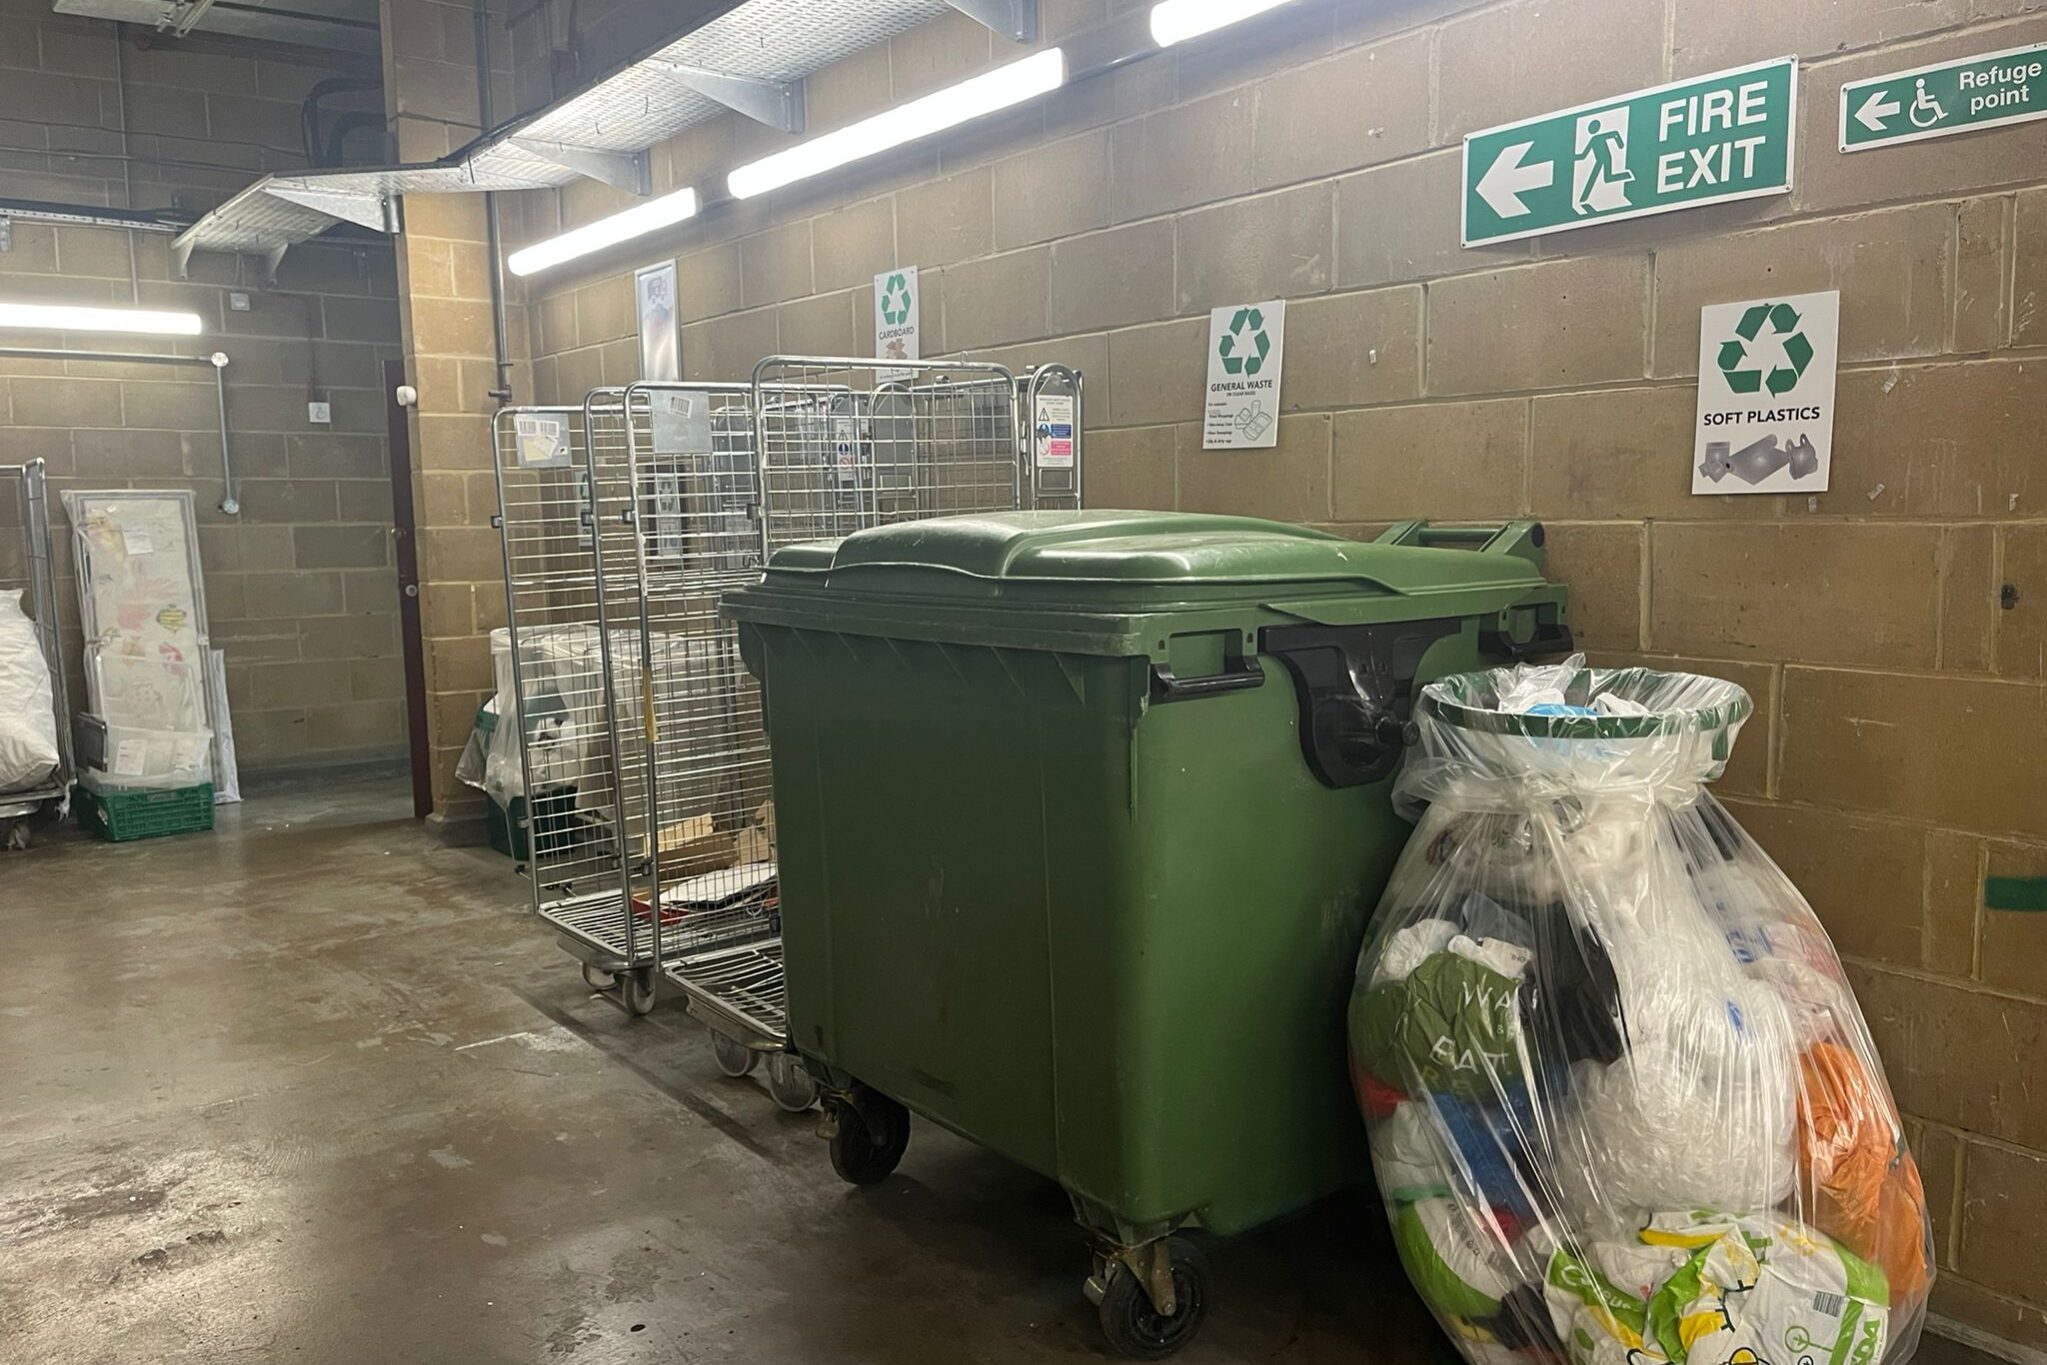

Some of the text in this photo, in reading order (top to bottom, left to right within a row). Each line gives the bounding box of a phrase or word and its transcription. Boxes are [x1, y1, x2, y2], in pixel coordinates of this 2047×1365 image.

[1959, 62, 2043, 89] Refuge
[1658, 80, 1769, 142] FIRE
[1970, 85, 2030, 115] point
[1656, 136, 1766, 194] EXIT
[878, 326, 915, 340] CARDBOARD
[1211, 379, 1273, 392] GENERAL WASTE
[1703, 406, 1821, 427] SOFT PLASTICS
